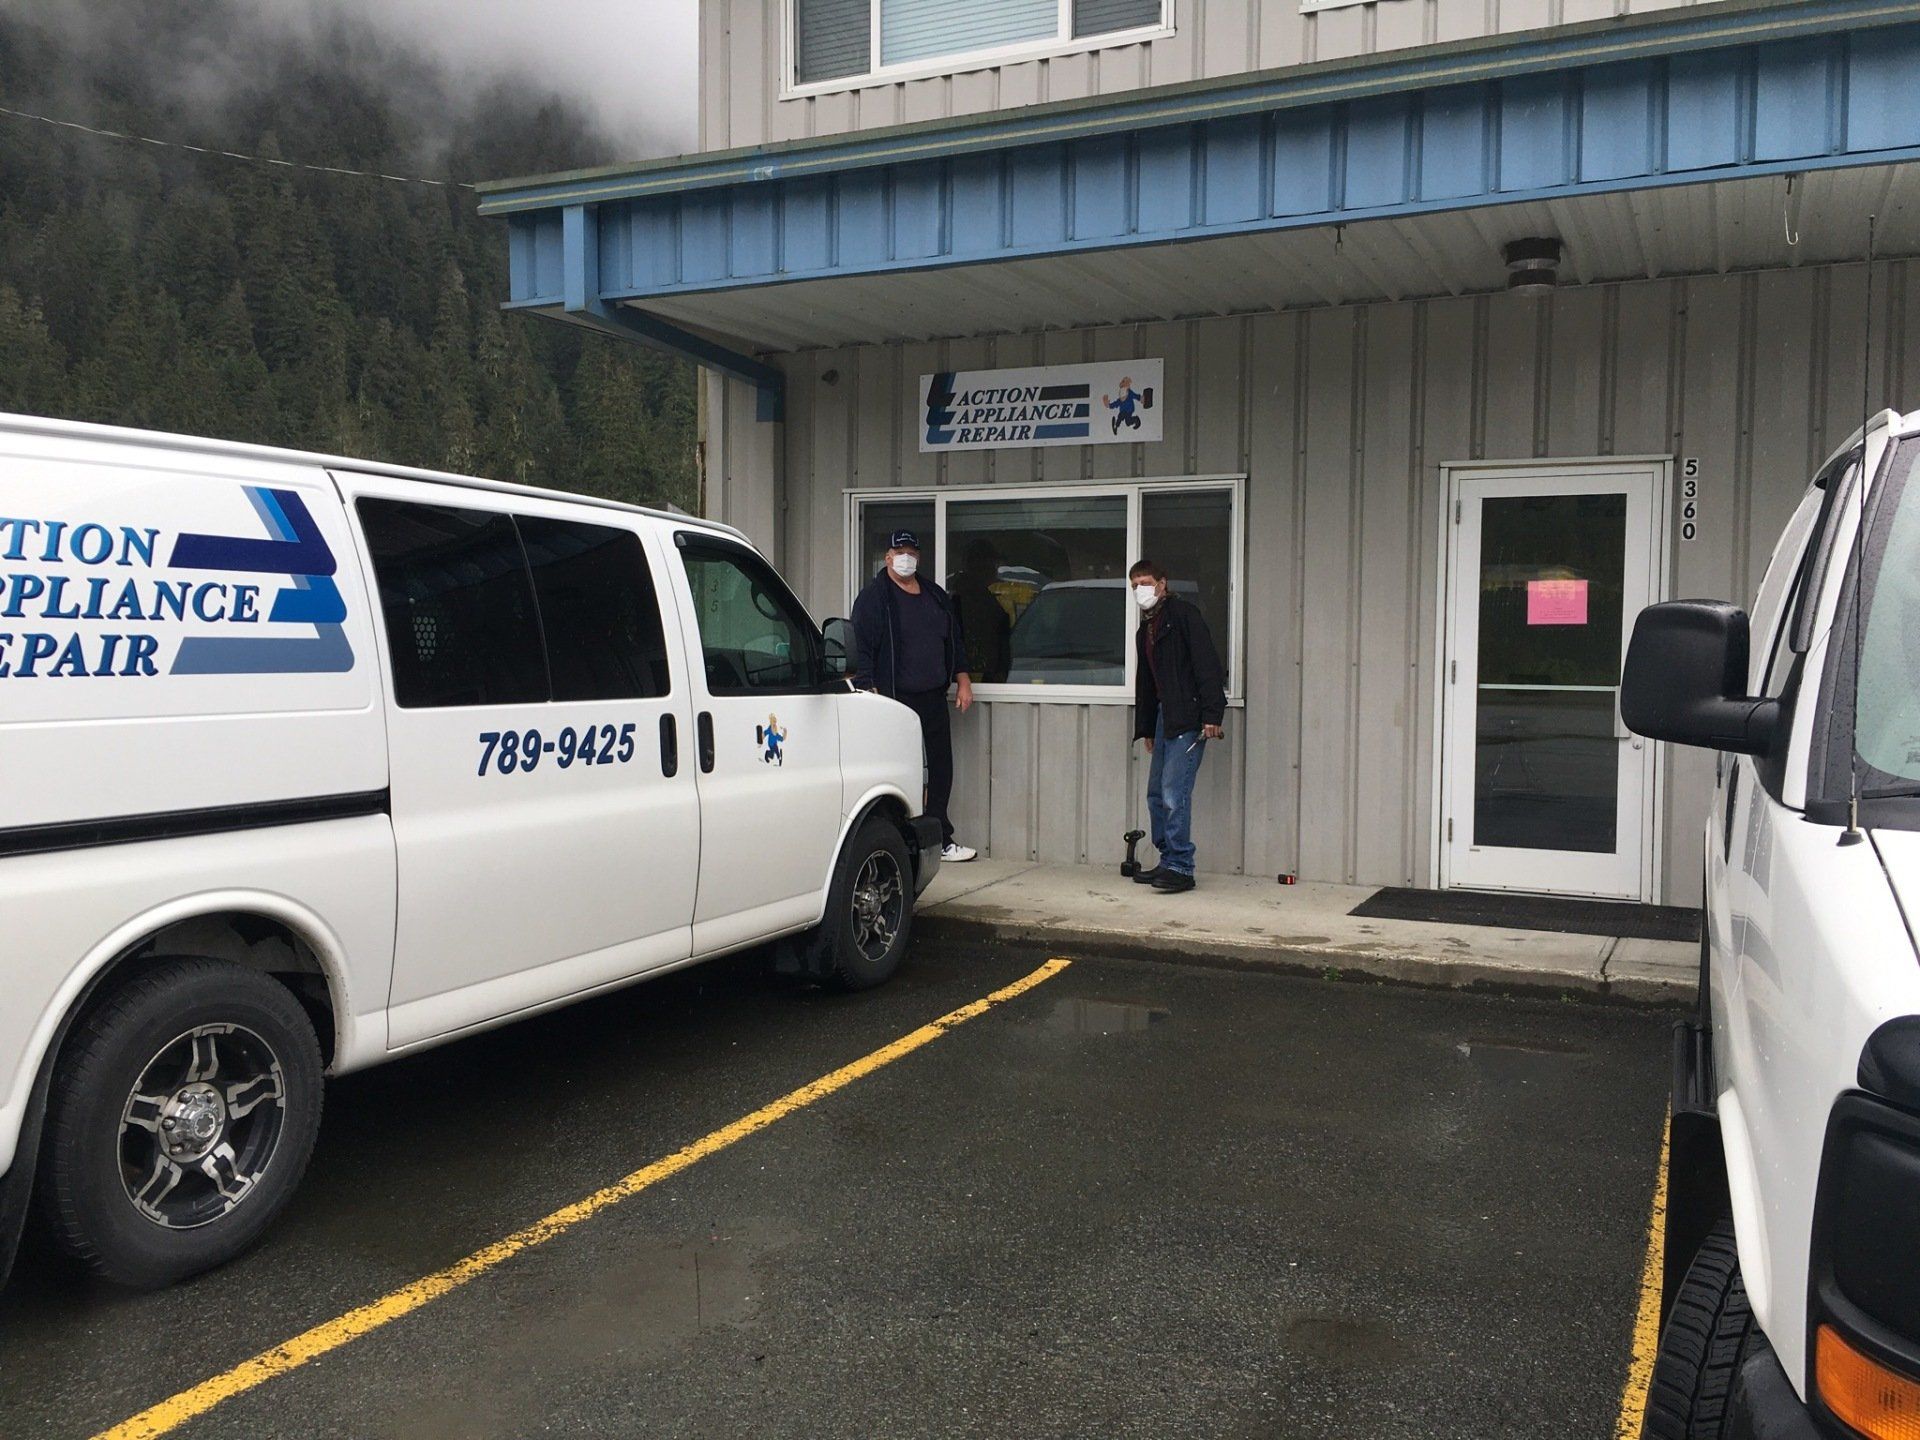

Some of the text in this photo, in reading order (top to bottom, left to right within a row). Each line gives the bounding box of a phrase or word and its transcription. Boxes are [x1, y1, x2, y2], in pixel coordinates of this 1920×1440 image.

[957, 387, 1039, 406] ACTION
[957, 404, 1073, 424] APPLIANCE
[957, 425, 1031, 443] REPAIR
[1682, 459, 1697, 540] 5360
[0, 574, 260, 623] PLIANCE
[477, 723, 636, 777] 789-9425
